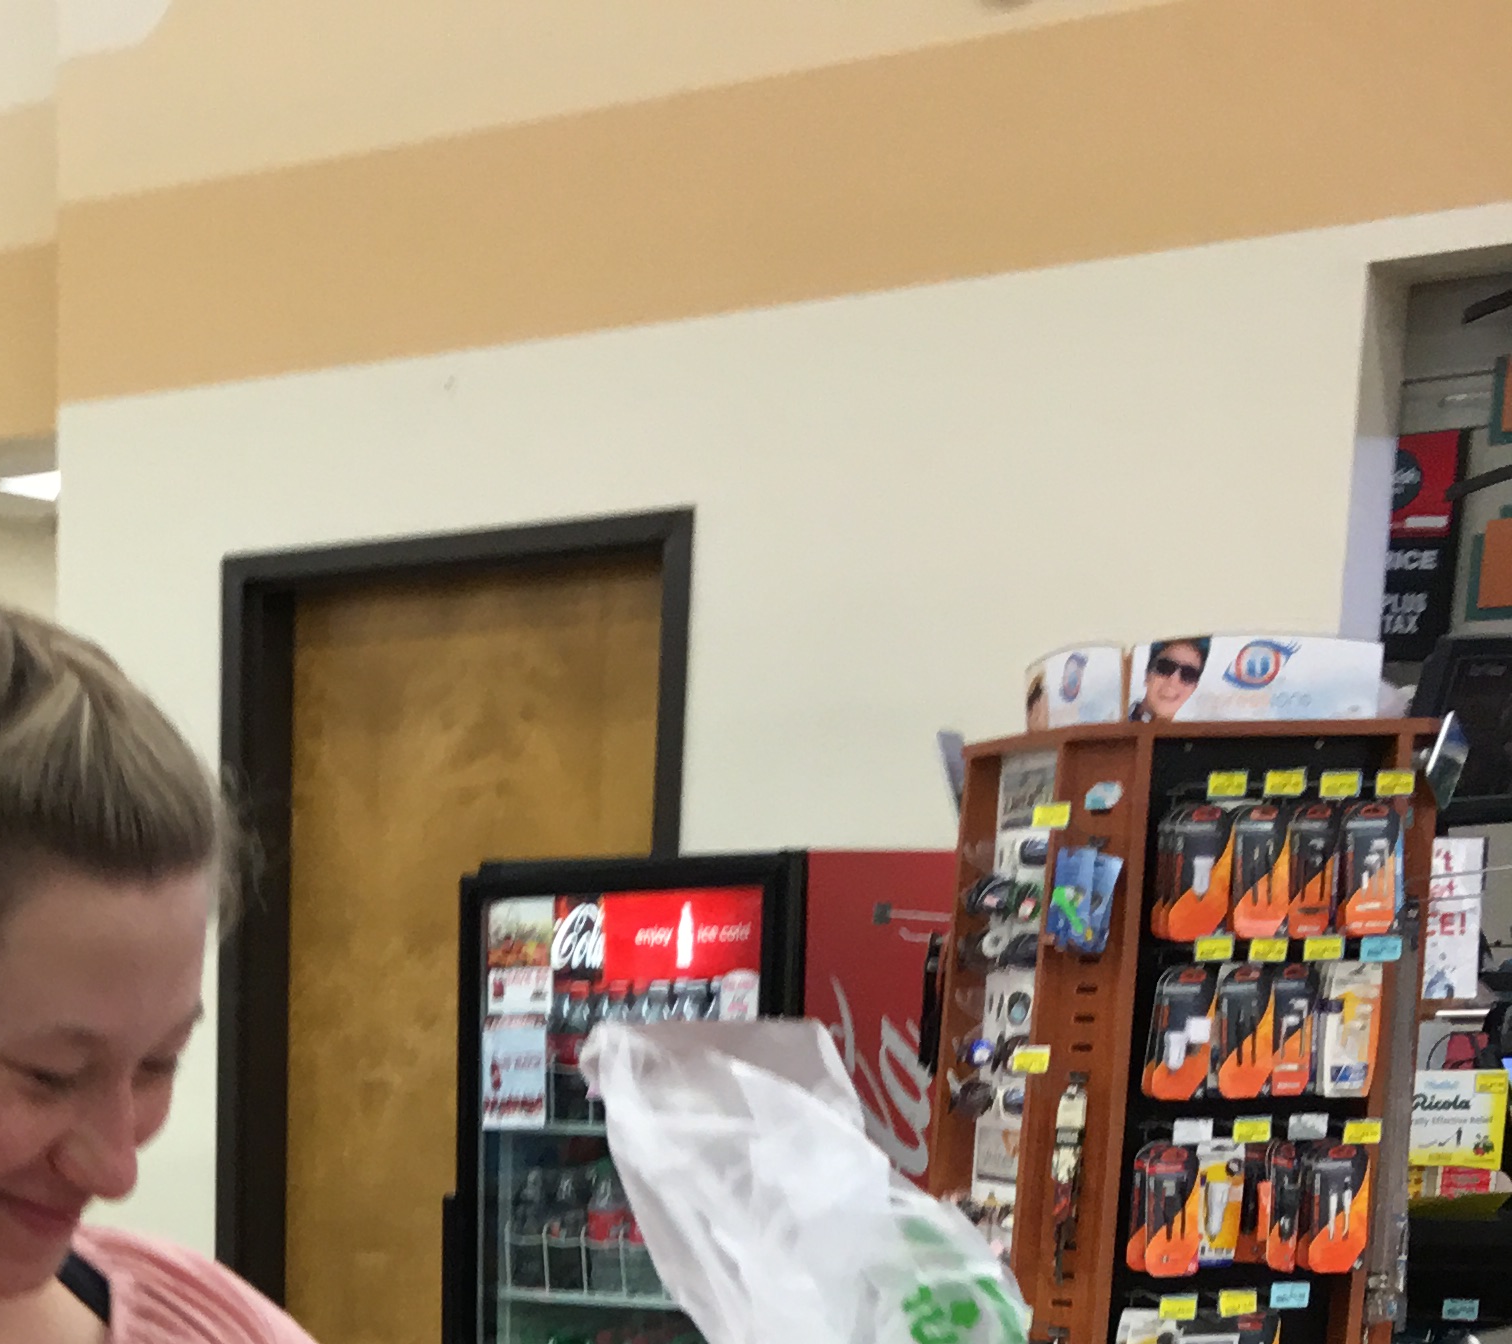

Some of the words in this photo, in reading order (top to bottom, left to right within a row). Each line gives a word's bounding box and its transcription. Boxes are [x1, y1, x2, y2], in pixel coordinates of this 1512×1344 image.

[635, 925, 674, 948] enjoy
[697, 922, 717, 943] ice
[1412, 1093, 1471, 1111] Ricola
